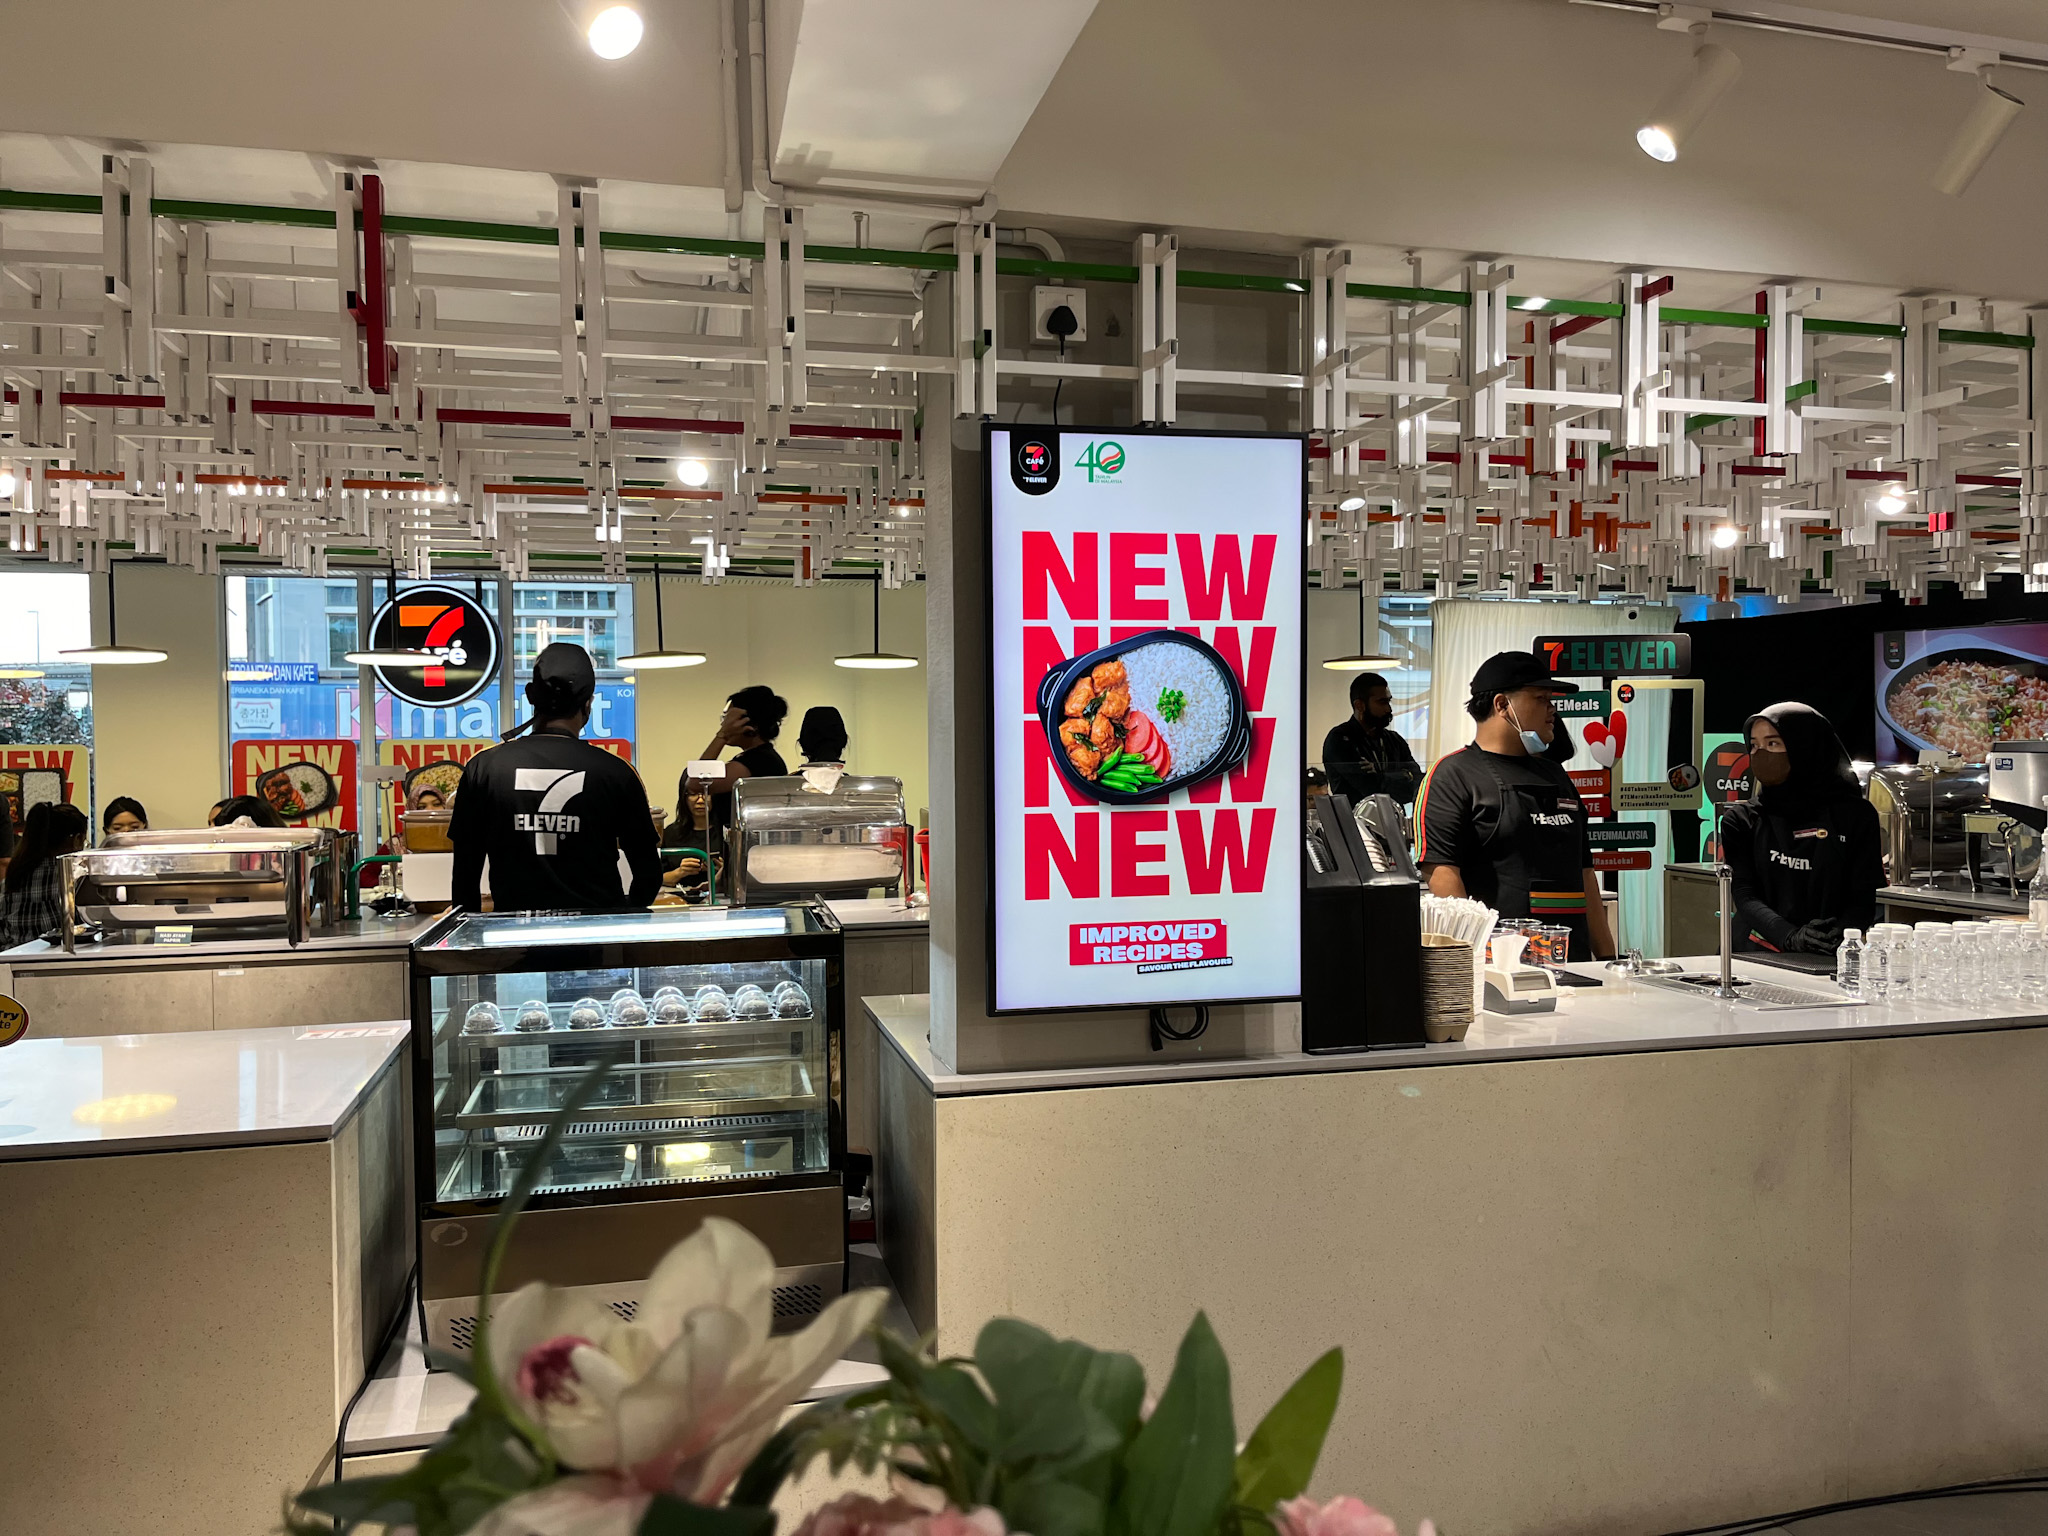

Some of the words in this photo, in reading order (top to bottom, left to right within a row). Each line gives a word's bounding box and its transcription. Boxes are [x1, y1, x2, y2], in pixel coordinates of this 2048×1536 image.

[1026, 446, 1044, 470] 7
[1074, 441, 1125, 483] 40
[1022, 531, 1277, 620] NEW
[399, 605, 465, 687] 7
[274, 664, 292, 681] DAN
[293, 664, 315, 681] KAFE
[0, 751, 74, 781] EW
[1572, 777, 1604, 787] MENTS
[1716, 776, 1749, 791] CAFé
[514, 768, 586, 855] 7
[514, 814, 580, 832] ELEVEn
[1024, 808, 1277, 900] NEW
[1080, 923, 1217, 944] IMPROVED
[1093, 942, 1204, 963] RECIPES
[1139, 963, 1173, 973] SAVOUR
[1173, 961, 1190, 970] THE
[1190, 957, 1233, 968] FLAVOURS
